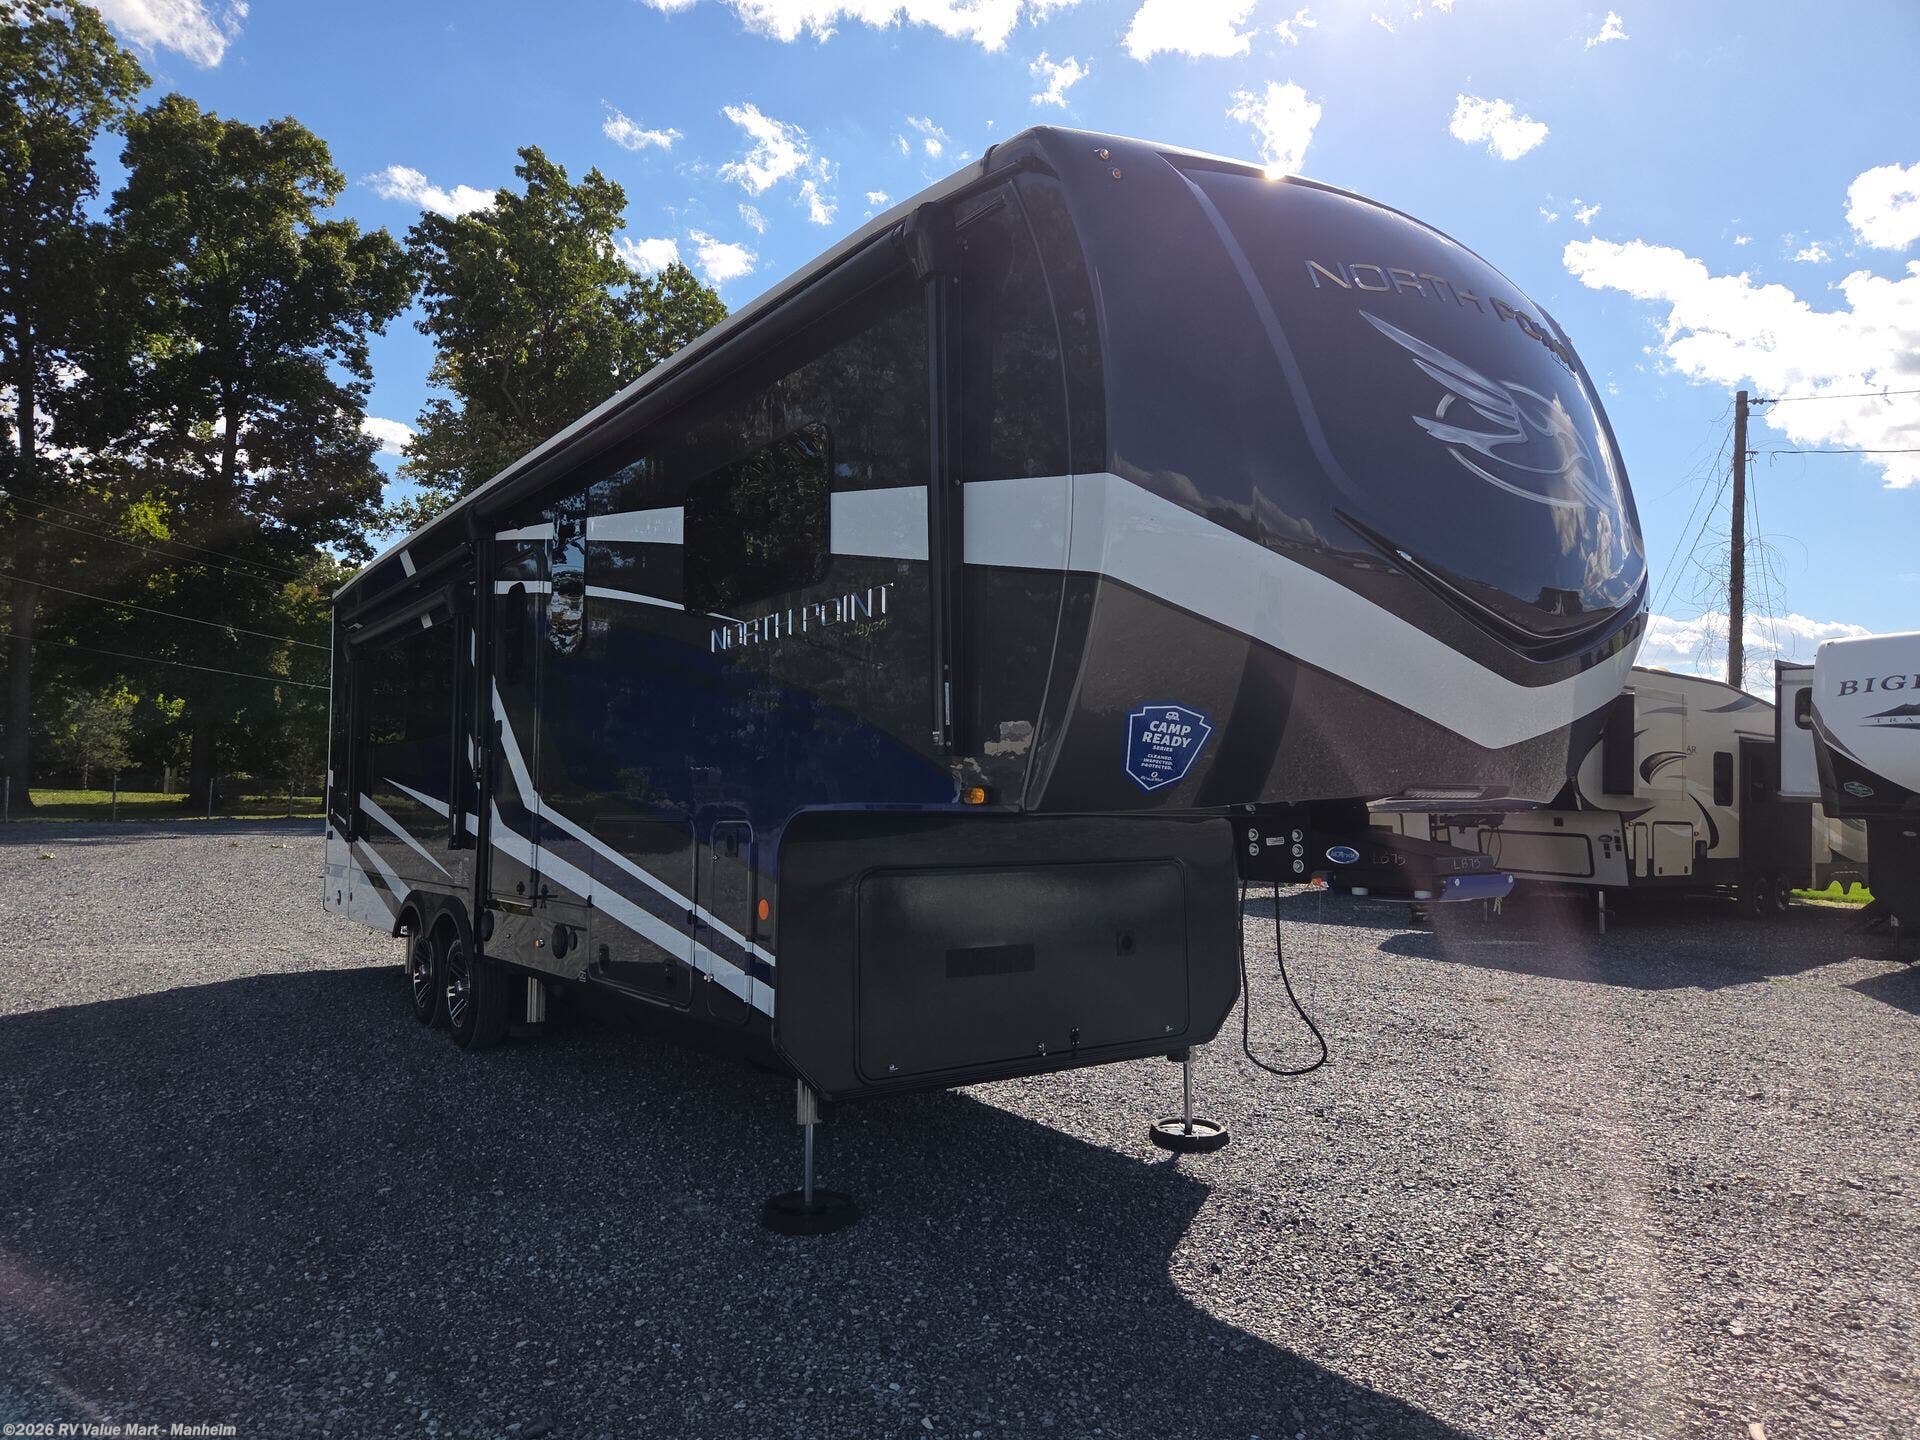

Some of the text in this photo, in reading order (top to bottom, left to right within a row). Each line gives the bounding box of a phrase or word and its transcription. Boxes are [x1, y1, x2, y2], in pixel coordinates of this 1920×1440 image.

[1304, 259, 1485, 314] NORTH
[710, 582, 893, 653] NORTH POINT
[1141, 731, 1192, 748] READY
[1149, 720, 1192, 736] CAMP
